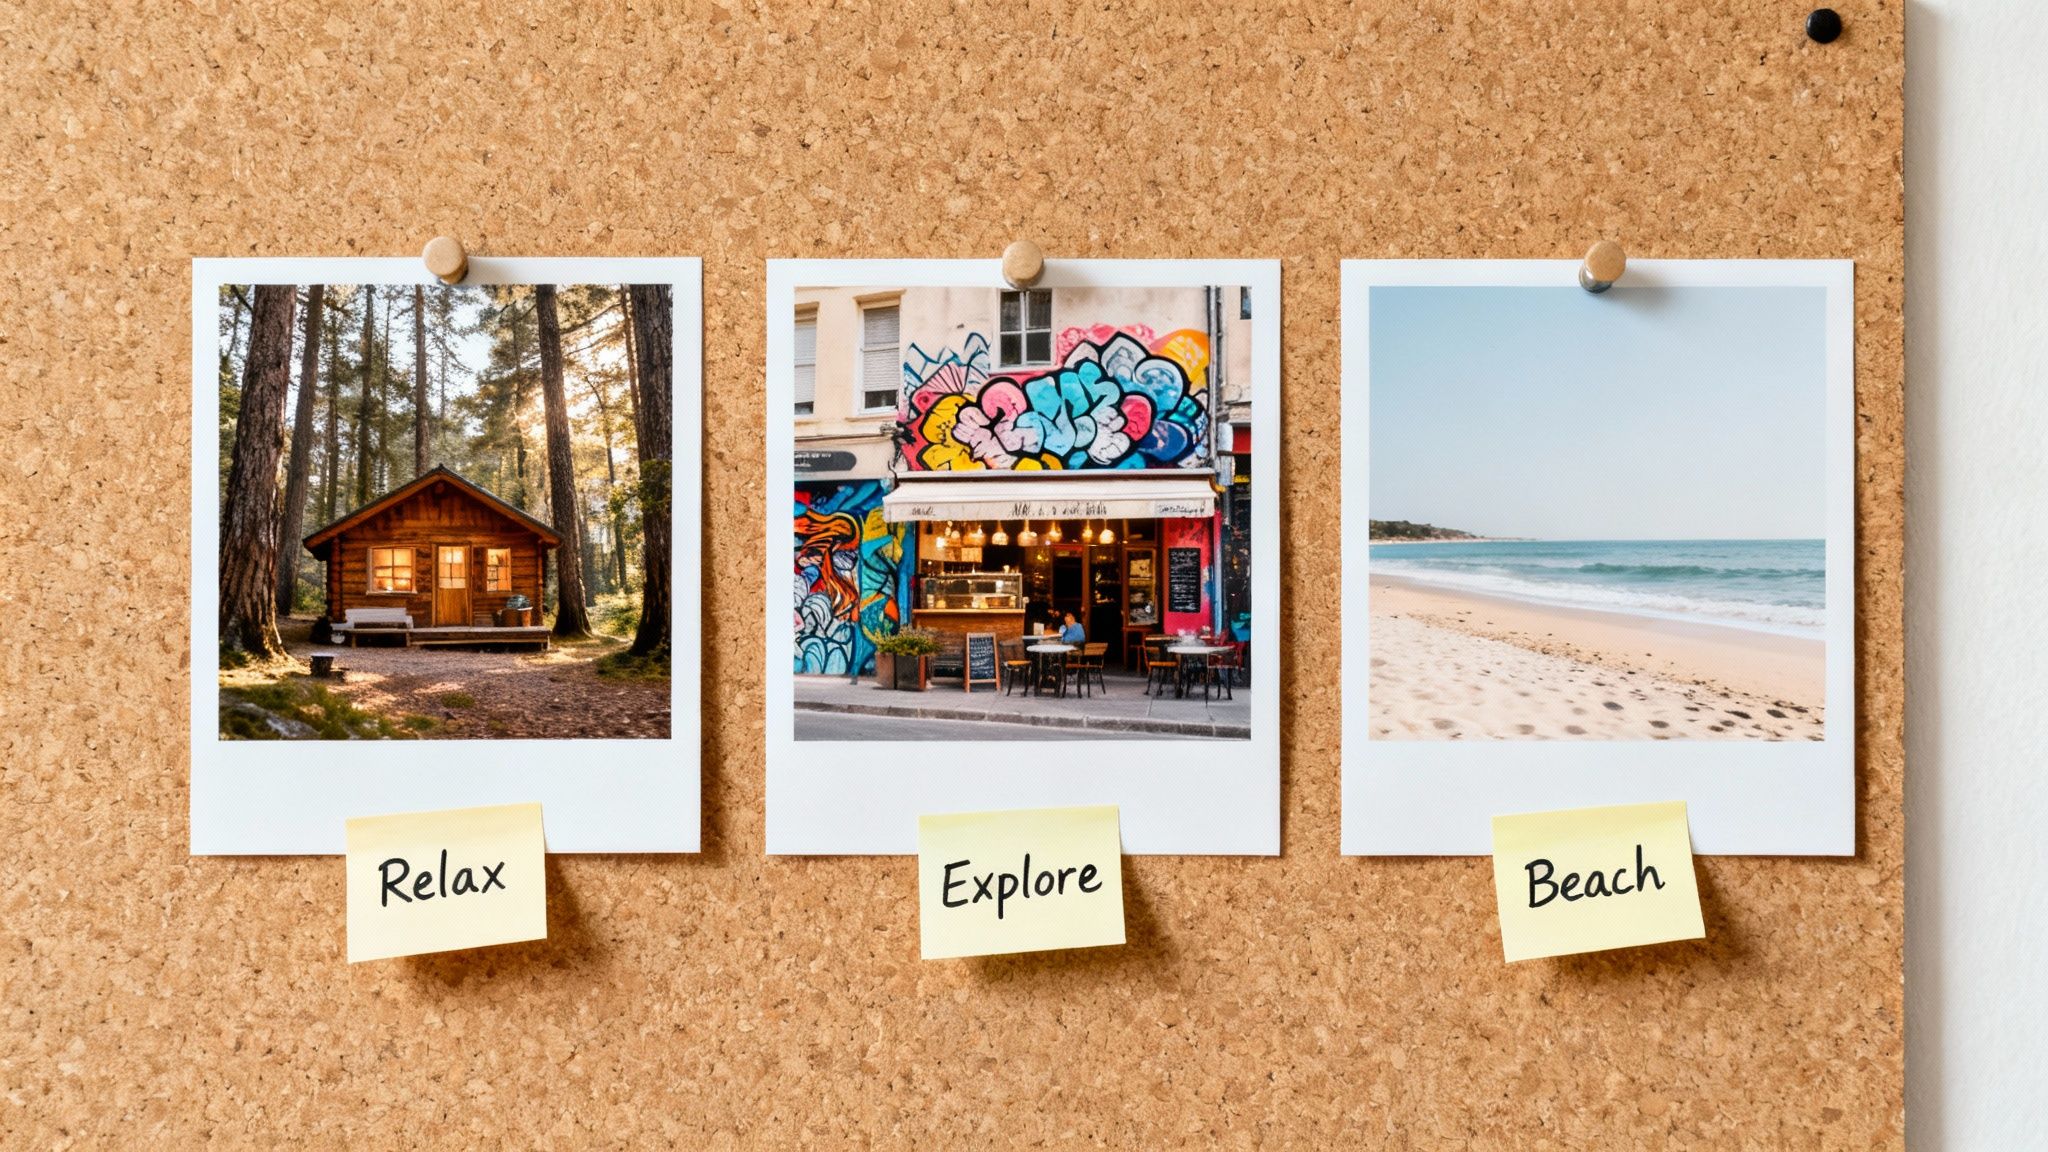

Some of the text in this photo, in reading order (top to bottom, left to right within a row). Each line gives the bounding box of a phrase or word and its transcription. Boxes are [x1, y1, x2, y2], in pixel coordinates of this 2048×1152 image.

[379, 848, 506, 908] Relax
[943, 853, 1103, 920] Explore
[1525, 844, 1666, 909] Beach
